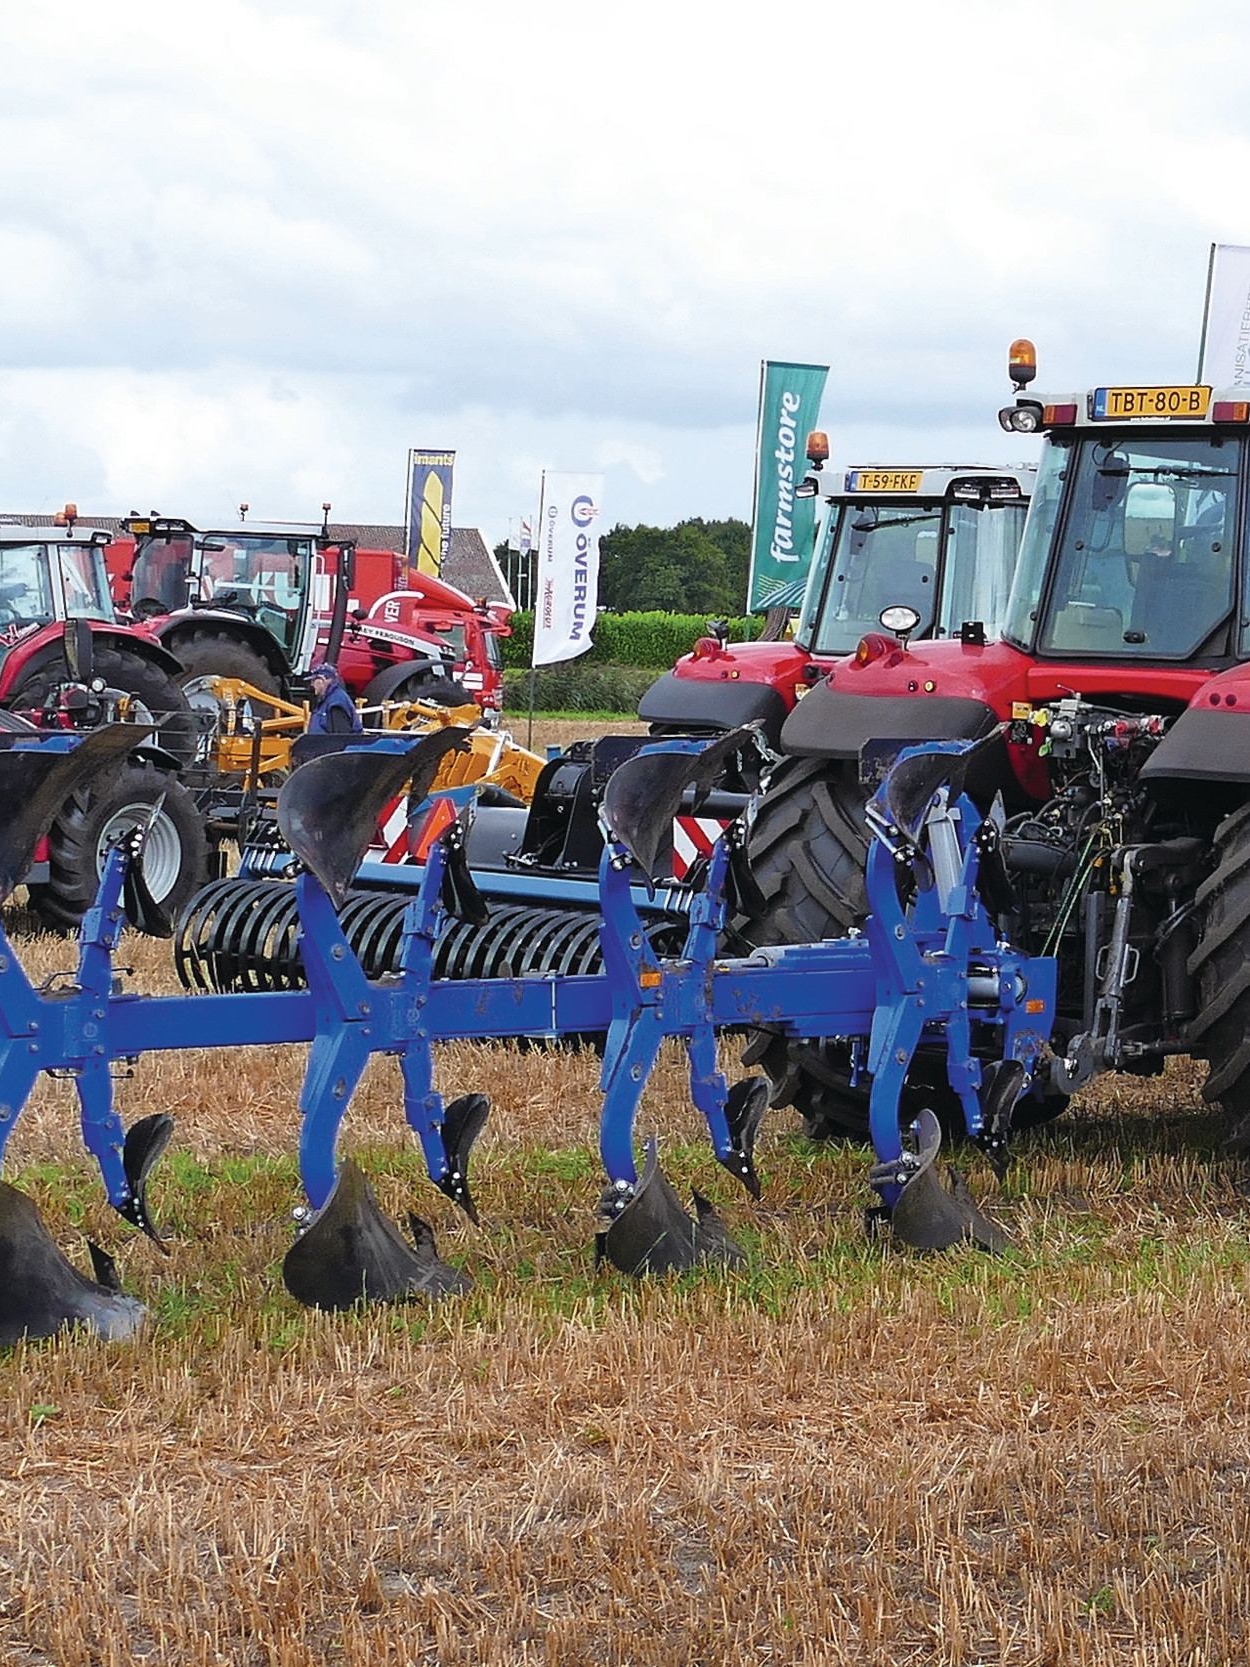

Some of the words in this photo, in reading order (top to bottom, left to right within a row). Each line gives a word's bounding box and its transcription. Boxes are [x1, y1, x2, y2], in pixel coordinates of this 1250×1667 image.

[1111, 391, 1201, 412] TBT-80-B
[770, 391, 800, 563] farmstore
[861, 474, 917, 489] T-59-FKF
[569, 532, 591, 640] ÖVERUM
